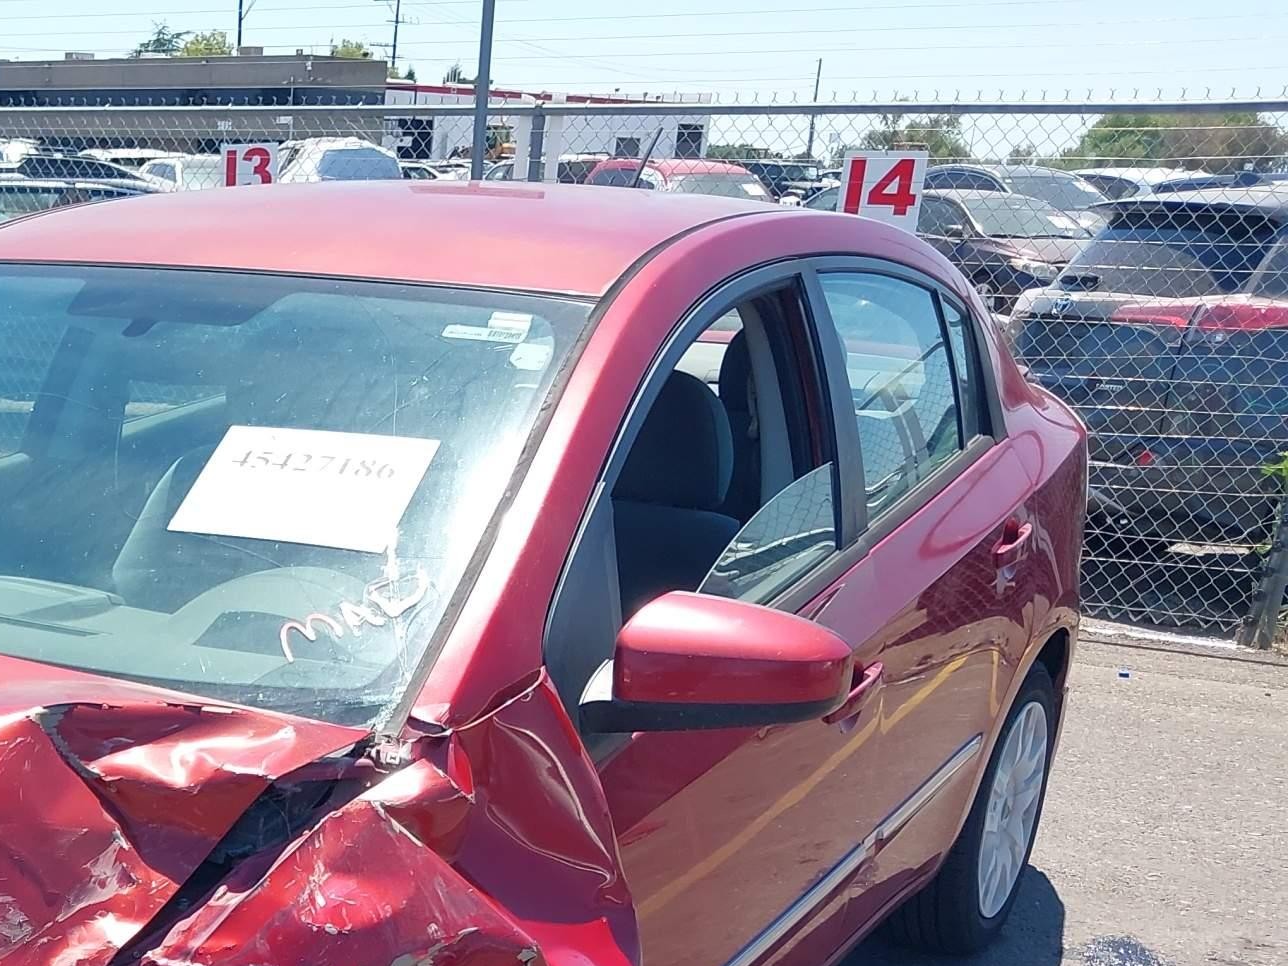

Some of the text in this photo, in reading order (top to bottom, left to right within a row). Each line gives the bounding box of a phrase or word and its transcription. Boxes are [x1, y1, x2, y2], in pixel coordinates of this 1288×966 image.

[225, 147, 273, 187] 13
[843, 157, 917, 216] 14
[231, 450, 397, 480] 45427186
